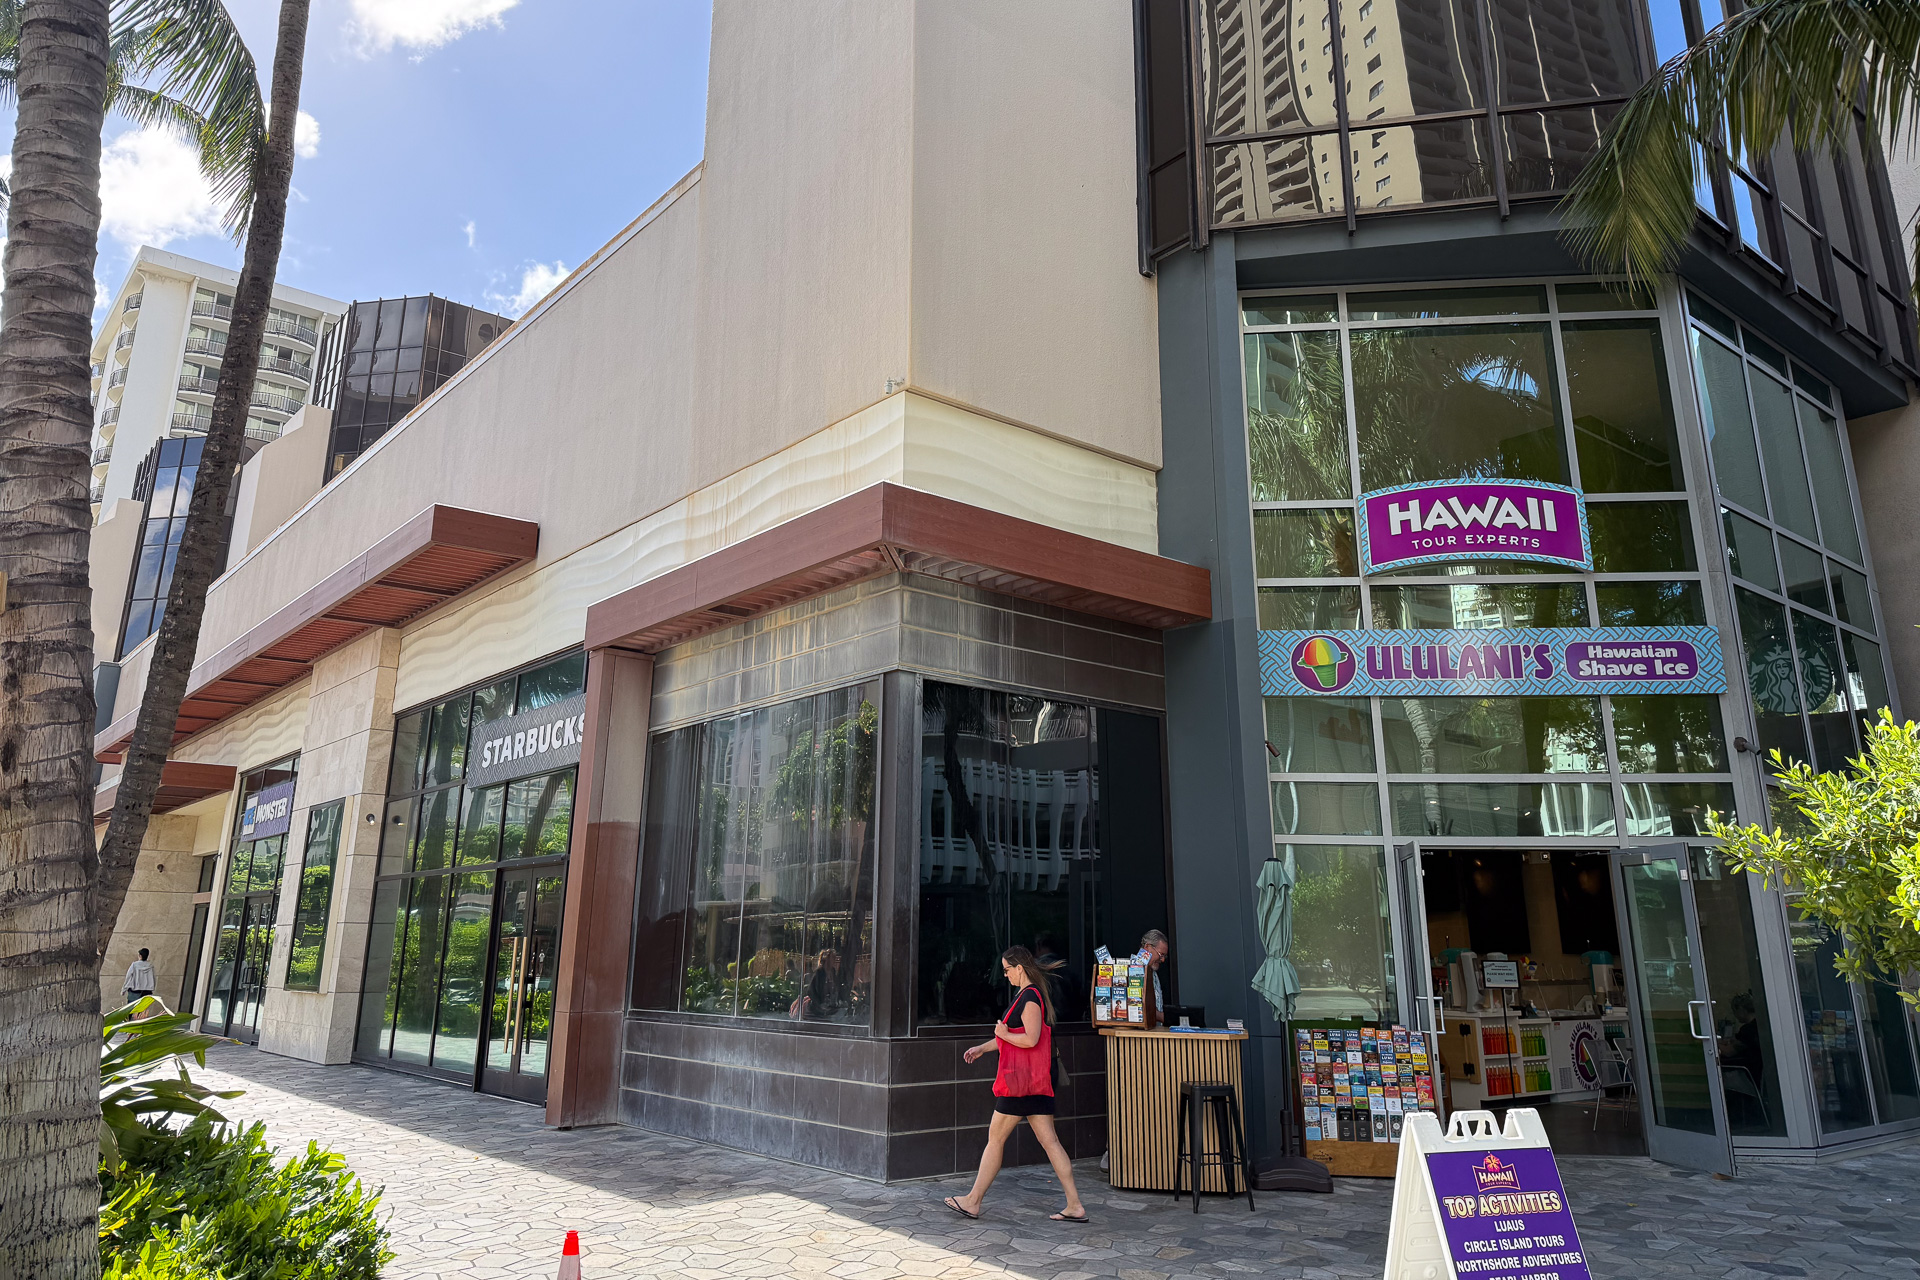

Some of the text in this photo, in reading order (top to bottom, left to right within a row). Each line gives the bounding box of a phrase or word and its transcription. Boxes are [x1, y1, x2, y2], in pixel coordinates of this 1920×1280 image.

[1388, 495, 1558, 536] HAWAII
[1412, 534, 1541, 549] TOUR EXPERTS
[1587, 645, 1678, 659] Hawaiian
[1366, 644, 1554, 680] ULULANI'S
[1578, 660, 1689, 676] Shave Ice
[255, 797, 288, 824] MONSTER
[1478, 1170, 1515, 1183] HAWAII
[1443, 1191, 1562, 1218] TOP ACTIVITIES
[1494, 1219, 1525, 1232] LUAUS
[1464, 1235, 1565, 1253] CIRCLE ISLAND TOURS
[1456, 1252, 1582, 1273] NORTHSHORE ADVENTURES
